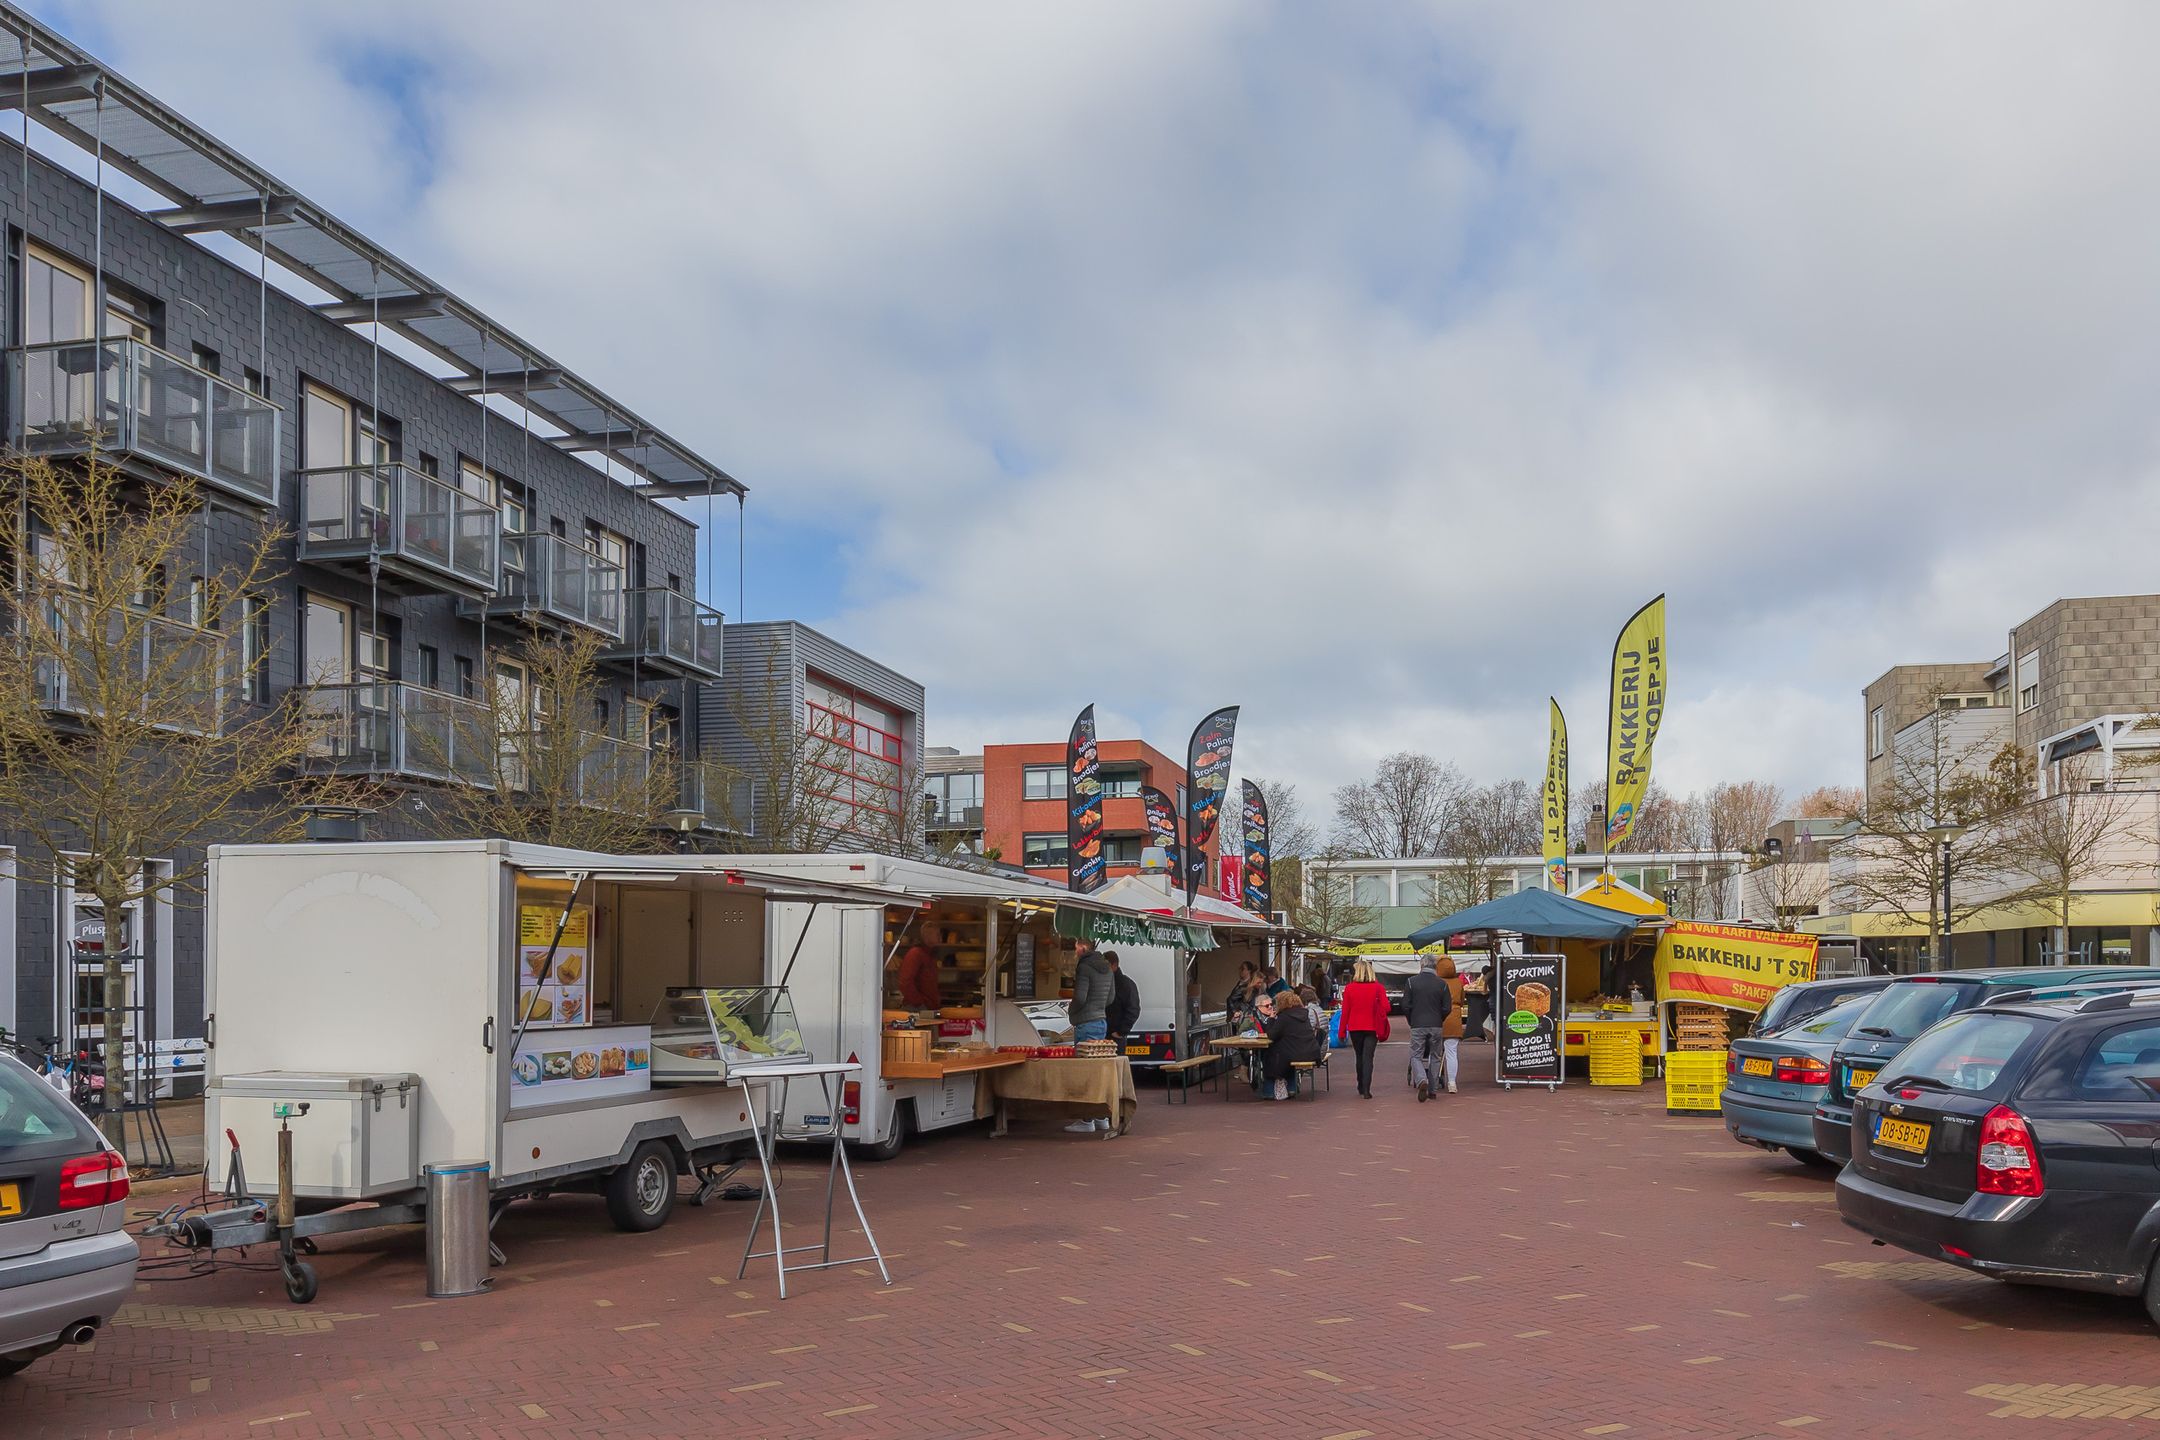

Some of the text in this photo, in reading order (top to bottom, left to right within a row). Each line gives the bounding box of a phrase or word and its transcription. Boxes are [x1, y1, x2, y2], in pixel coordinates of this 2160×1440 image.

[1645, 636, 1661, 754] TOEPJE
[1615, 650, 1641, 786] BAKKERIJ
[1200, 732, 1222, 744] Zalm
[1206, 736, 1233, 751] Paling
[1078, 738, 1097, 756] Paling
[1072, 762, 1100, 785] Broodjes
[1193, 760, 1231, 779] Broodjes
[1695, 923, 1719, 934] VAN
[1721, 925, 1753, 939] AART
[1673, 944, 1761, 972] BAKKERIJ
[1767, 957, 1784, 974] 'T
[1506, 965, 1555, 979] SPORTMIK
[1512, 1036, 1543, 1047] BROOD
[1529, 1043, 1550, 1051] MINSTE
[1507, 1050, 1553, 1061] KOOLHYDRATEN
[1520, 1056, 1555, 1066] NEDERLAND
[1882, 1121, 1926, 1145] 08-SB-FD
